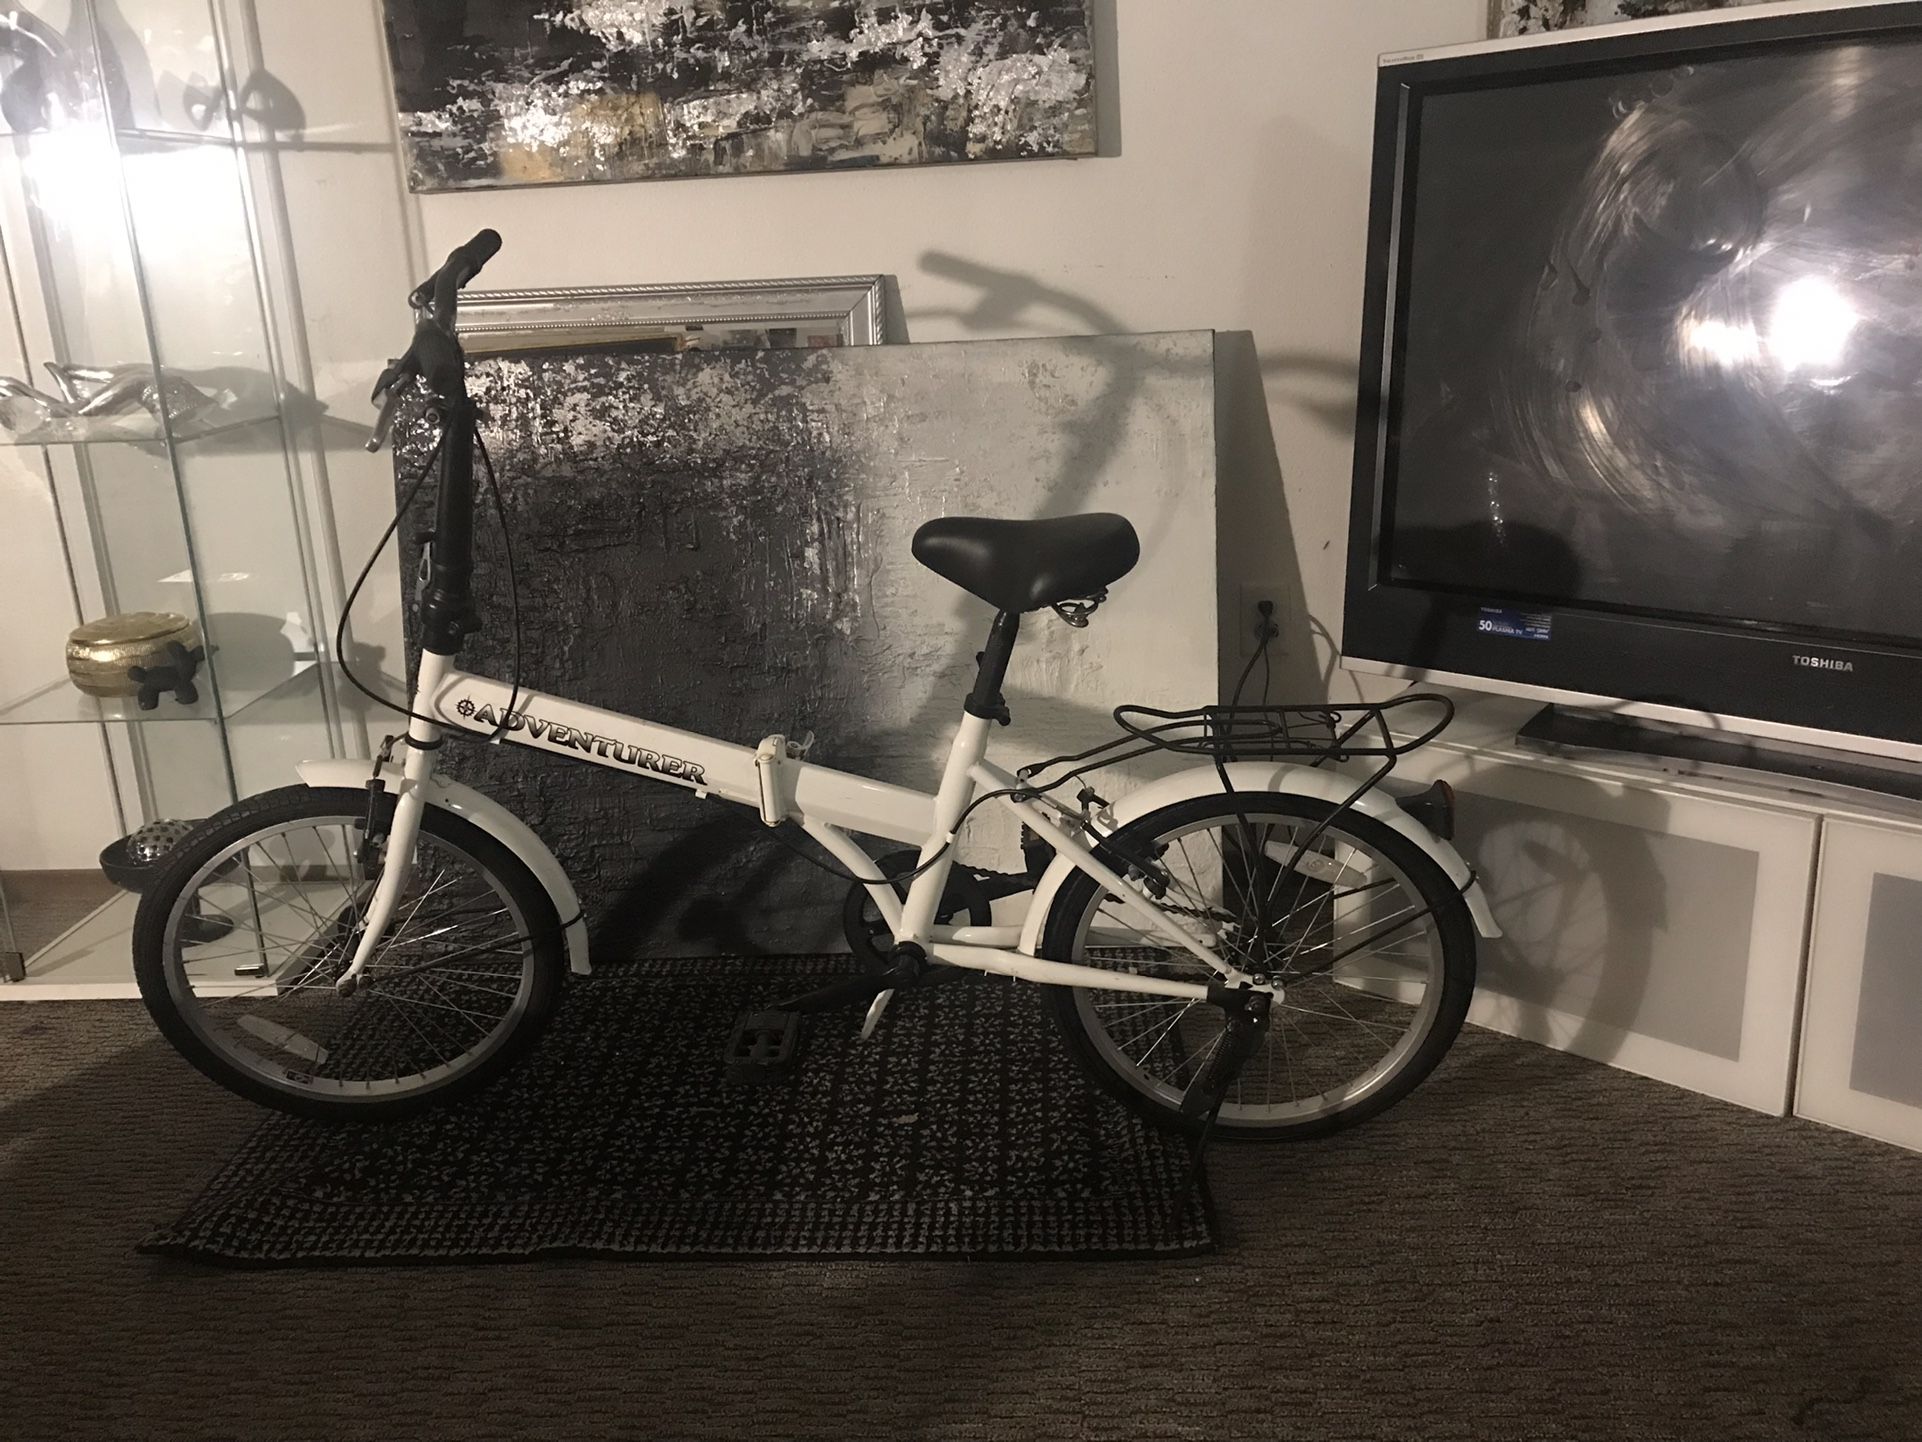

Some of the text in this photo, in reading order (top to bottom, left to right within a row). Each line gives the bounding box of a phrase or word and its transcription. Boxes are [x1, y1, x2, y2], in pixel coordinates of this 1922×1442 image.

[1478, 620, 1493, 631] 50
[1792, 655, 1853, 672] TOSHIBA
[473, 703, 707, 785] ADVENTURER
